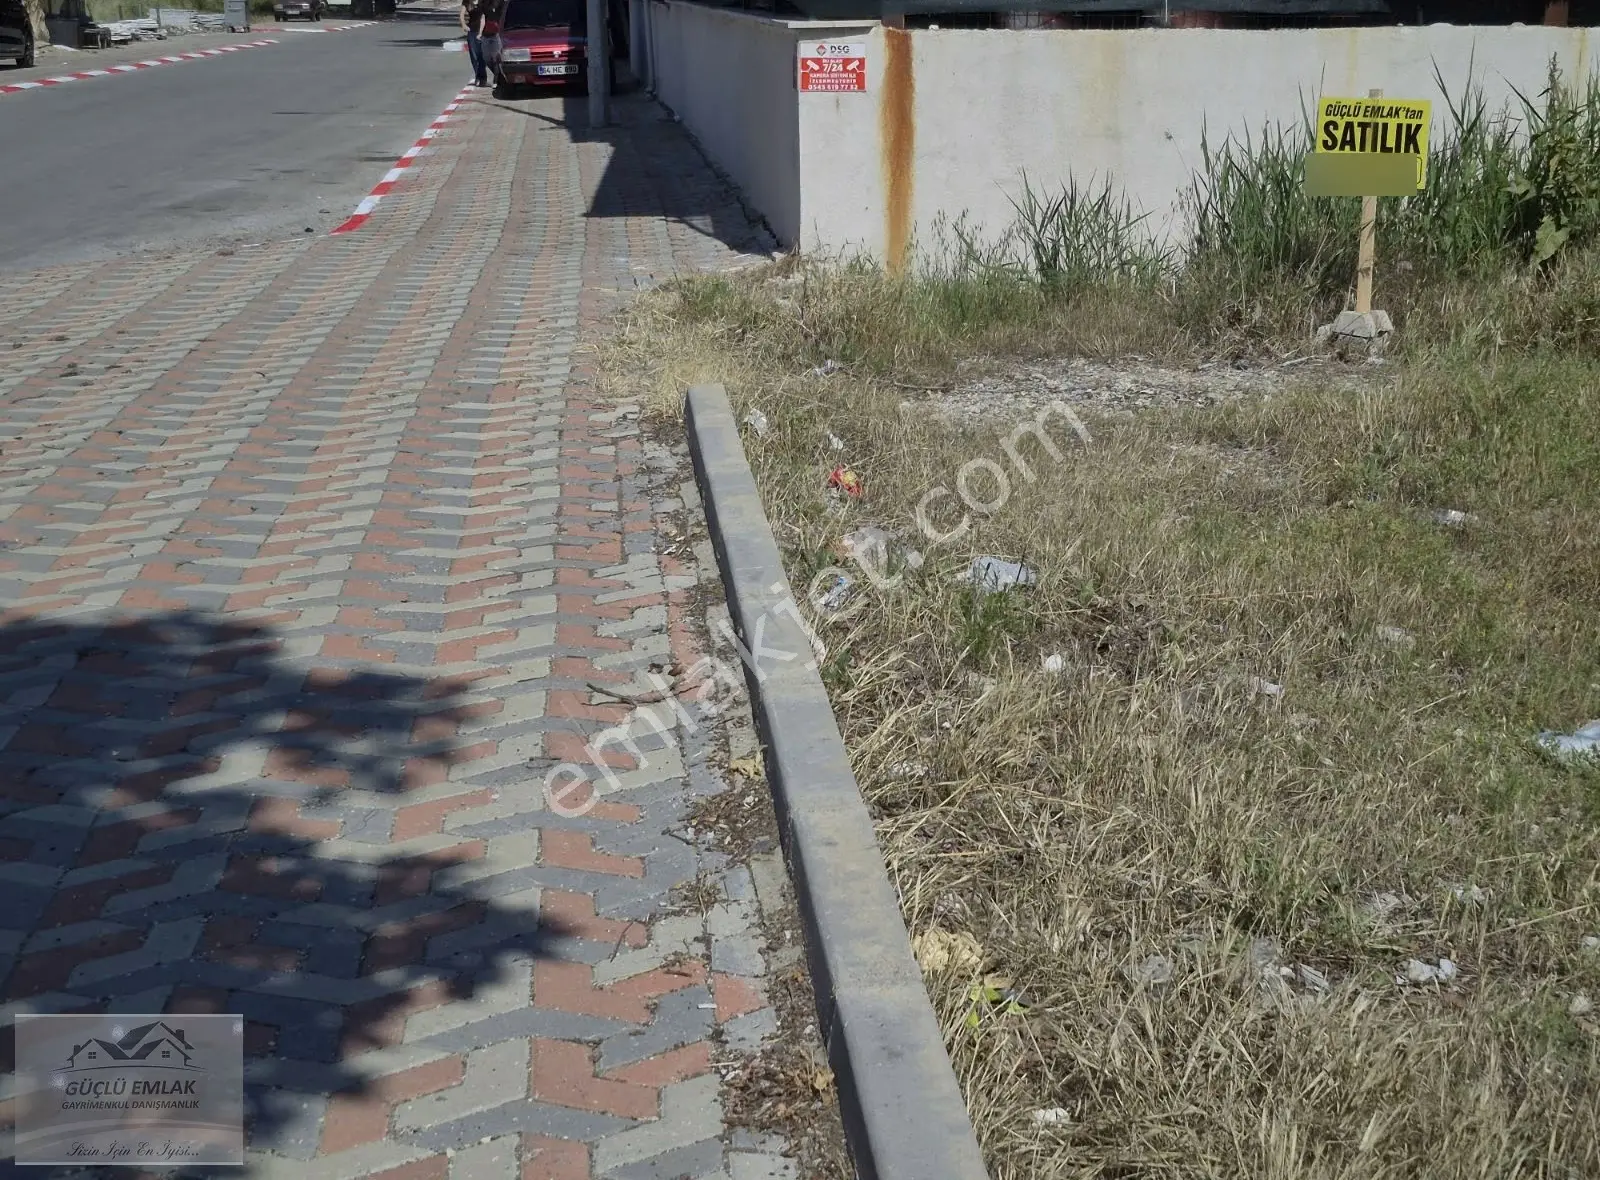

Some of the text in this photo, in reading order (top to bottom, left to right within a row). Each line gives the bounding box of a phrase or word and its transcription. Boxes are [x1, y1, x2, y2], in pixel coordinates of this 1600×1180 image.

[830, 45, 850, 54] DSG
[823, 63, 843, 73] 7/24
[1325, 101, 1361, 120] GÜÇLÜ
[1322, 120, 1423, 154] SATILIK
